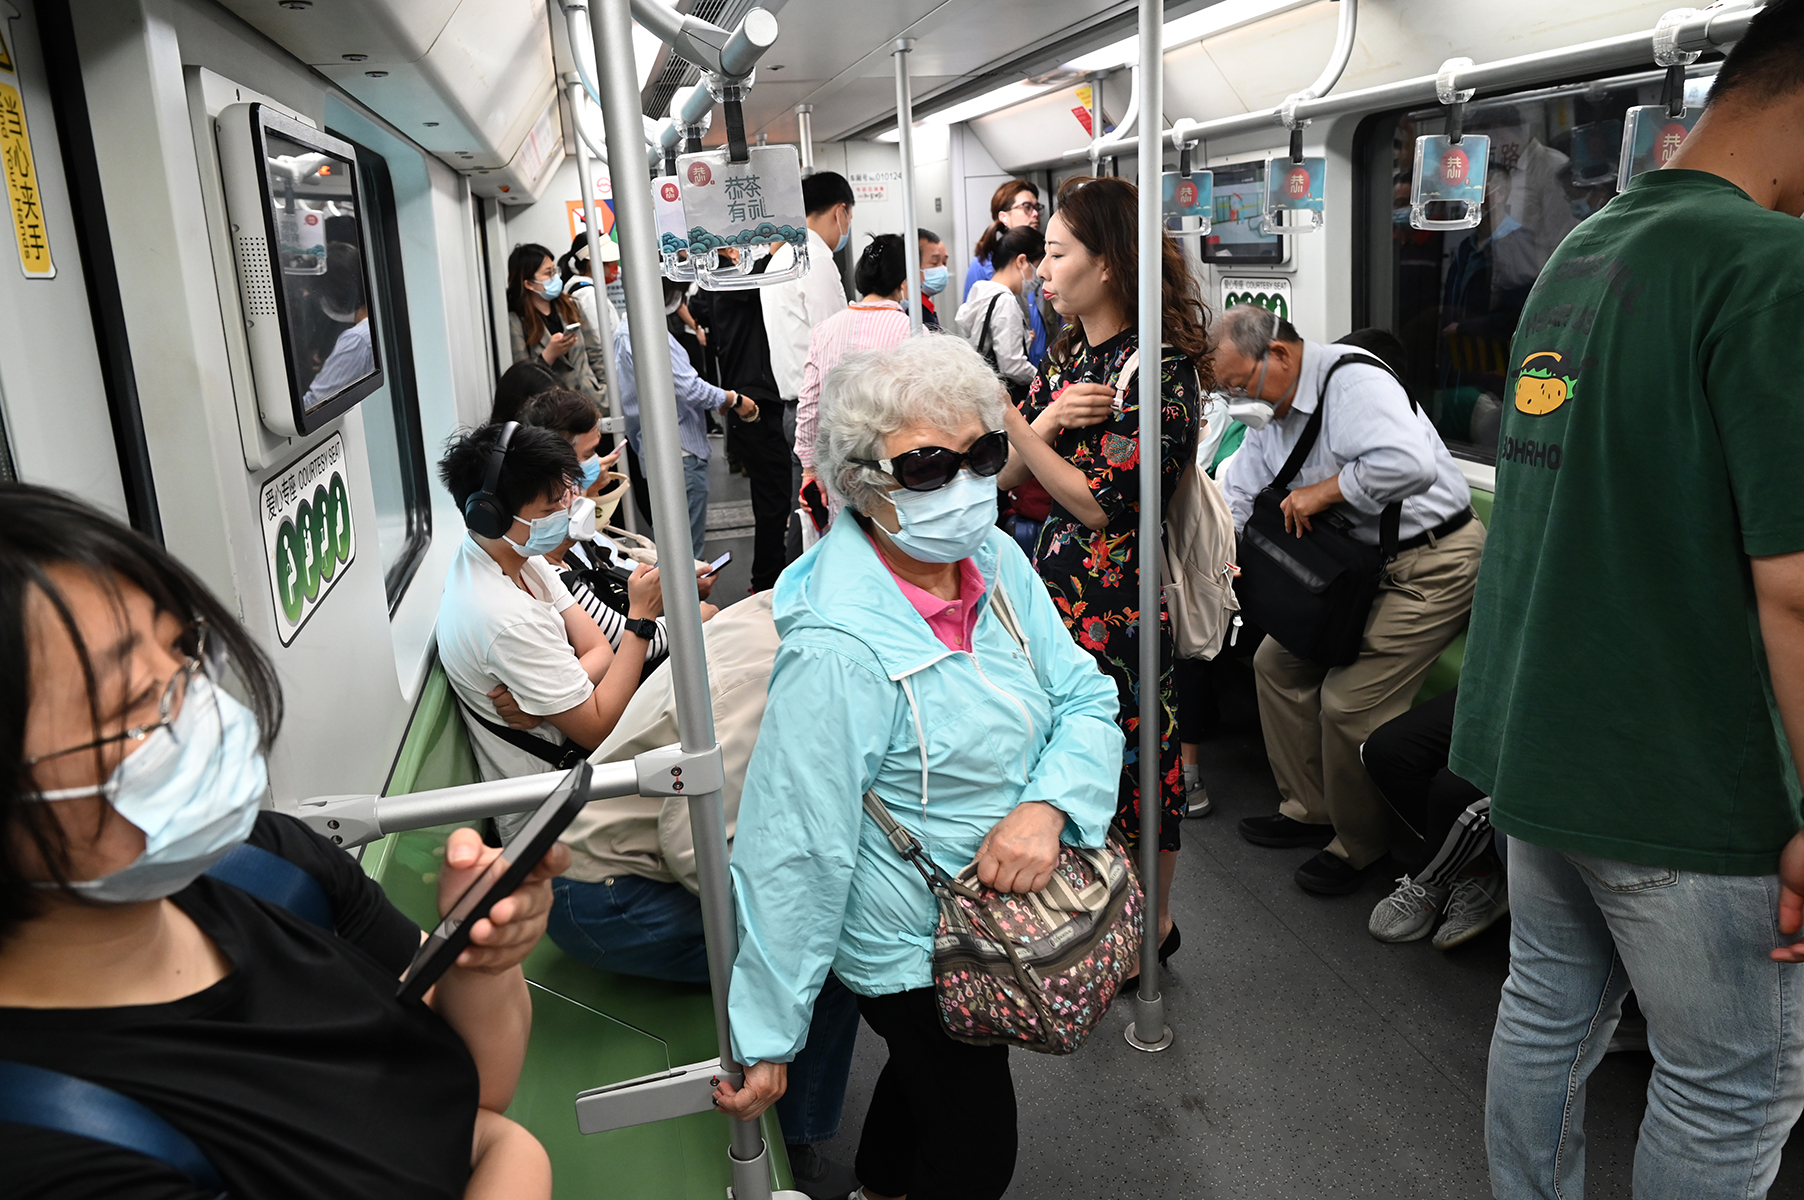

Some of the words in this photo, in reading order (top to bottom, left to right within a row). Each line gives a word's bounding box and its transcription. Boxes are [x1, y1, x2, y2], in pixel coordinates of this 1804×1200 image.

[4, 95, 45, 261] 当心夹手
[6, 146, 17, 191] Your
[14, 197, 31, 260] Hands
[725, 174, 762, 201] 恭茶
[727, 198, 775, 223] 有礼
[1245, 280, 1273, 290] COURTESY
[1273, 281, 1287, 290] SEAT
[265, 473, 298, 521] 爱心专座
[298, 451, 329, 490] COURTESY
[328, 441, 341, 466] SEAT
